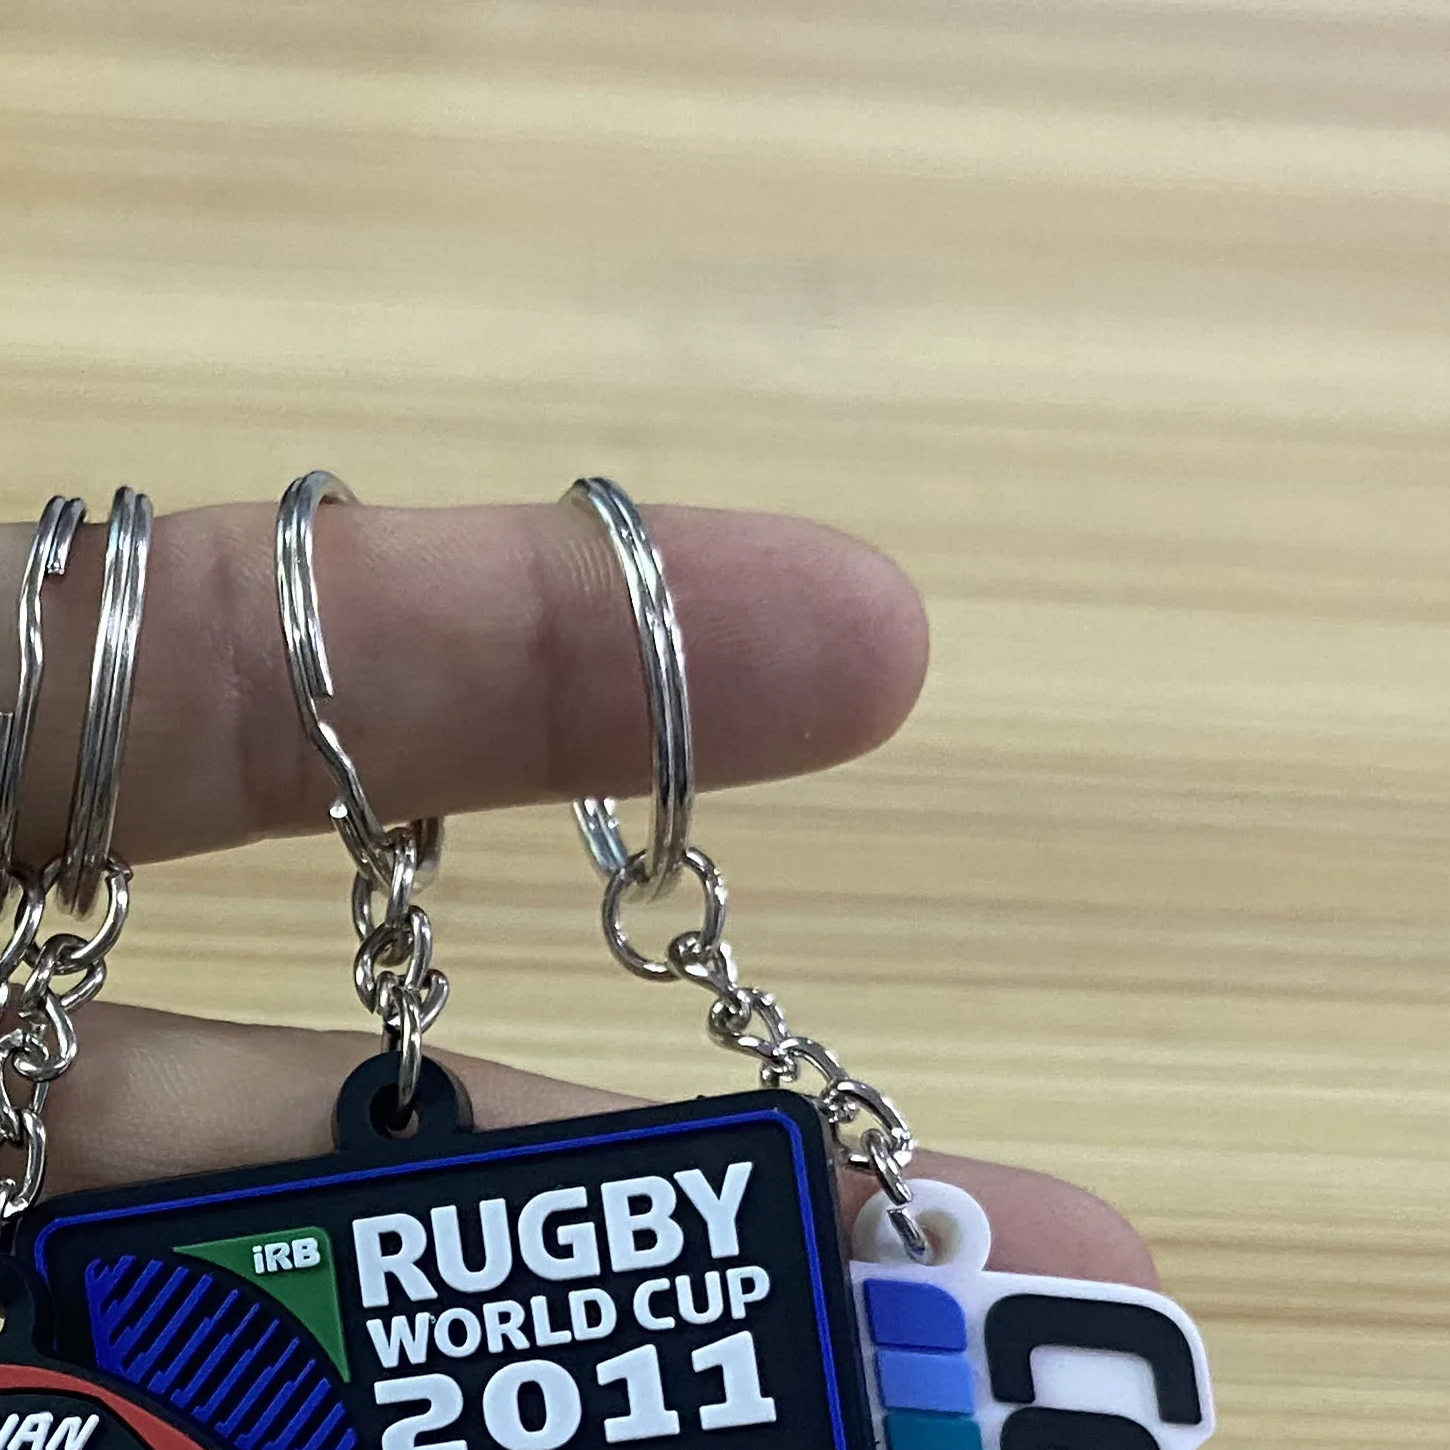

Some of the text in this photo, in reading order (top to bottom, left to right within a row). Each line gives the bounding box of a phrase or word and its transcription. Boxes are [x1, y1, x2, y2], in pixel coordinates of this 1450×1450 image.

[252, 1236, 322, 1274] iRB
[352, 1160, 754, 1310] RUGBY
[366, 1265, 771, 1369] WORLD CUP
